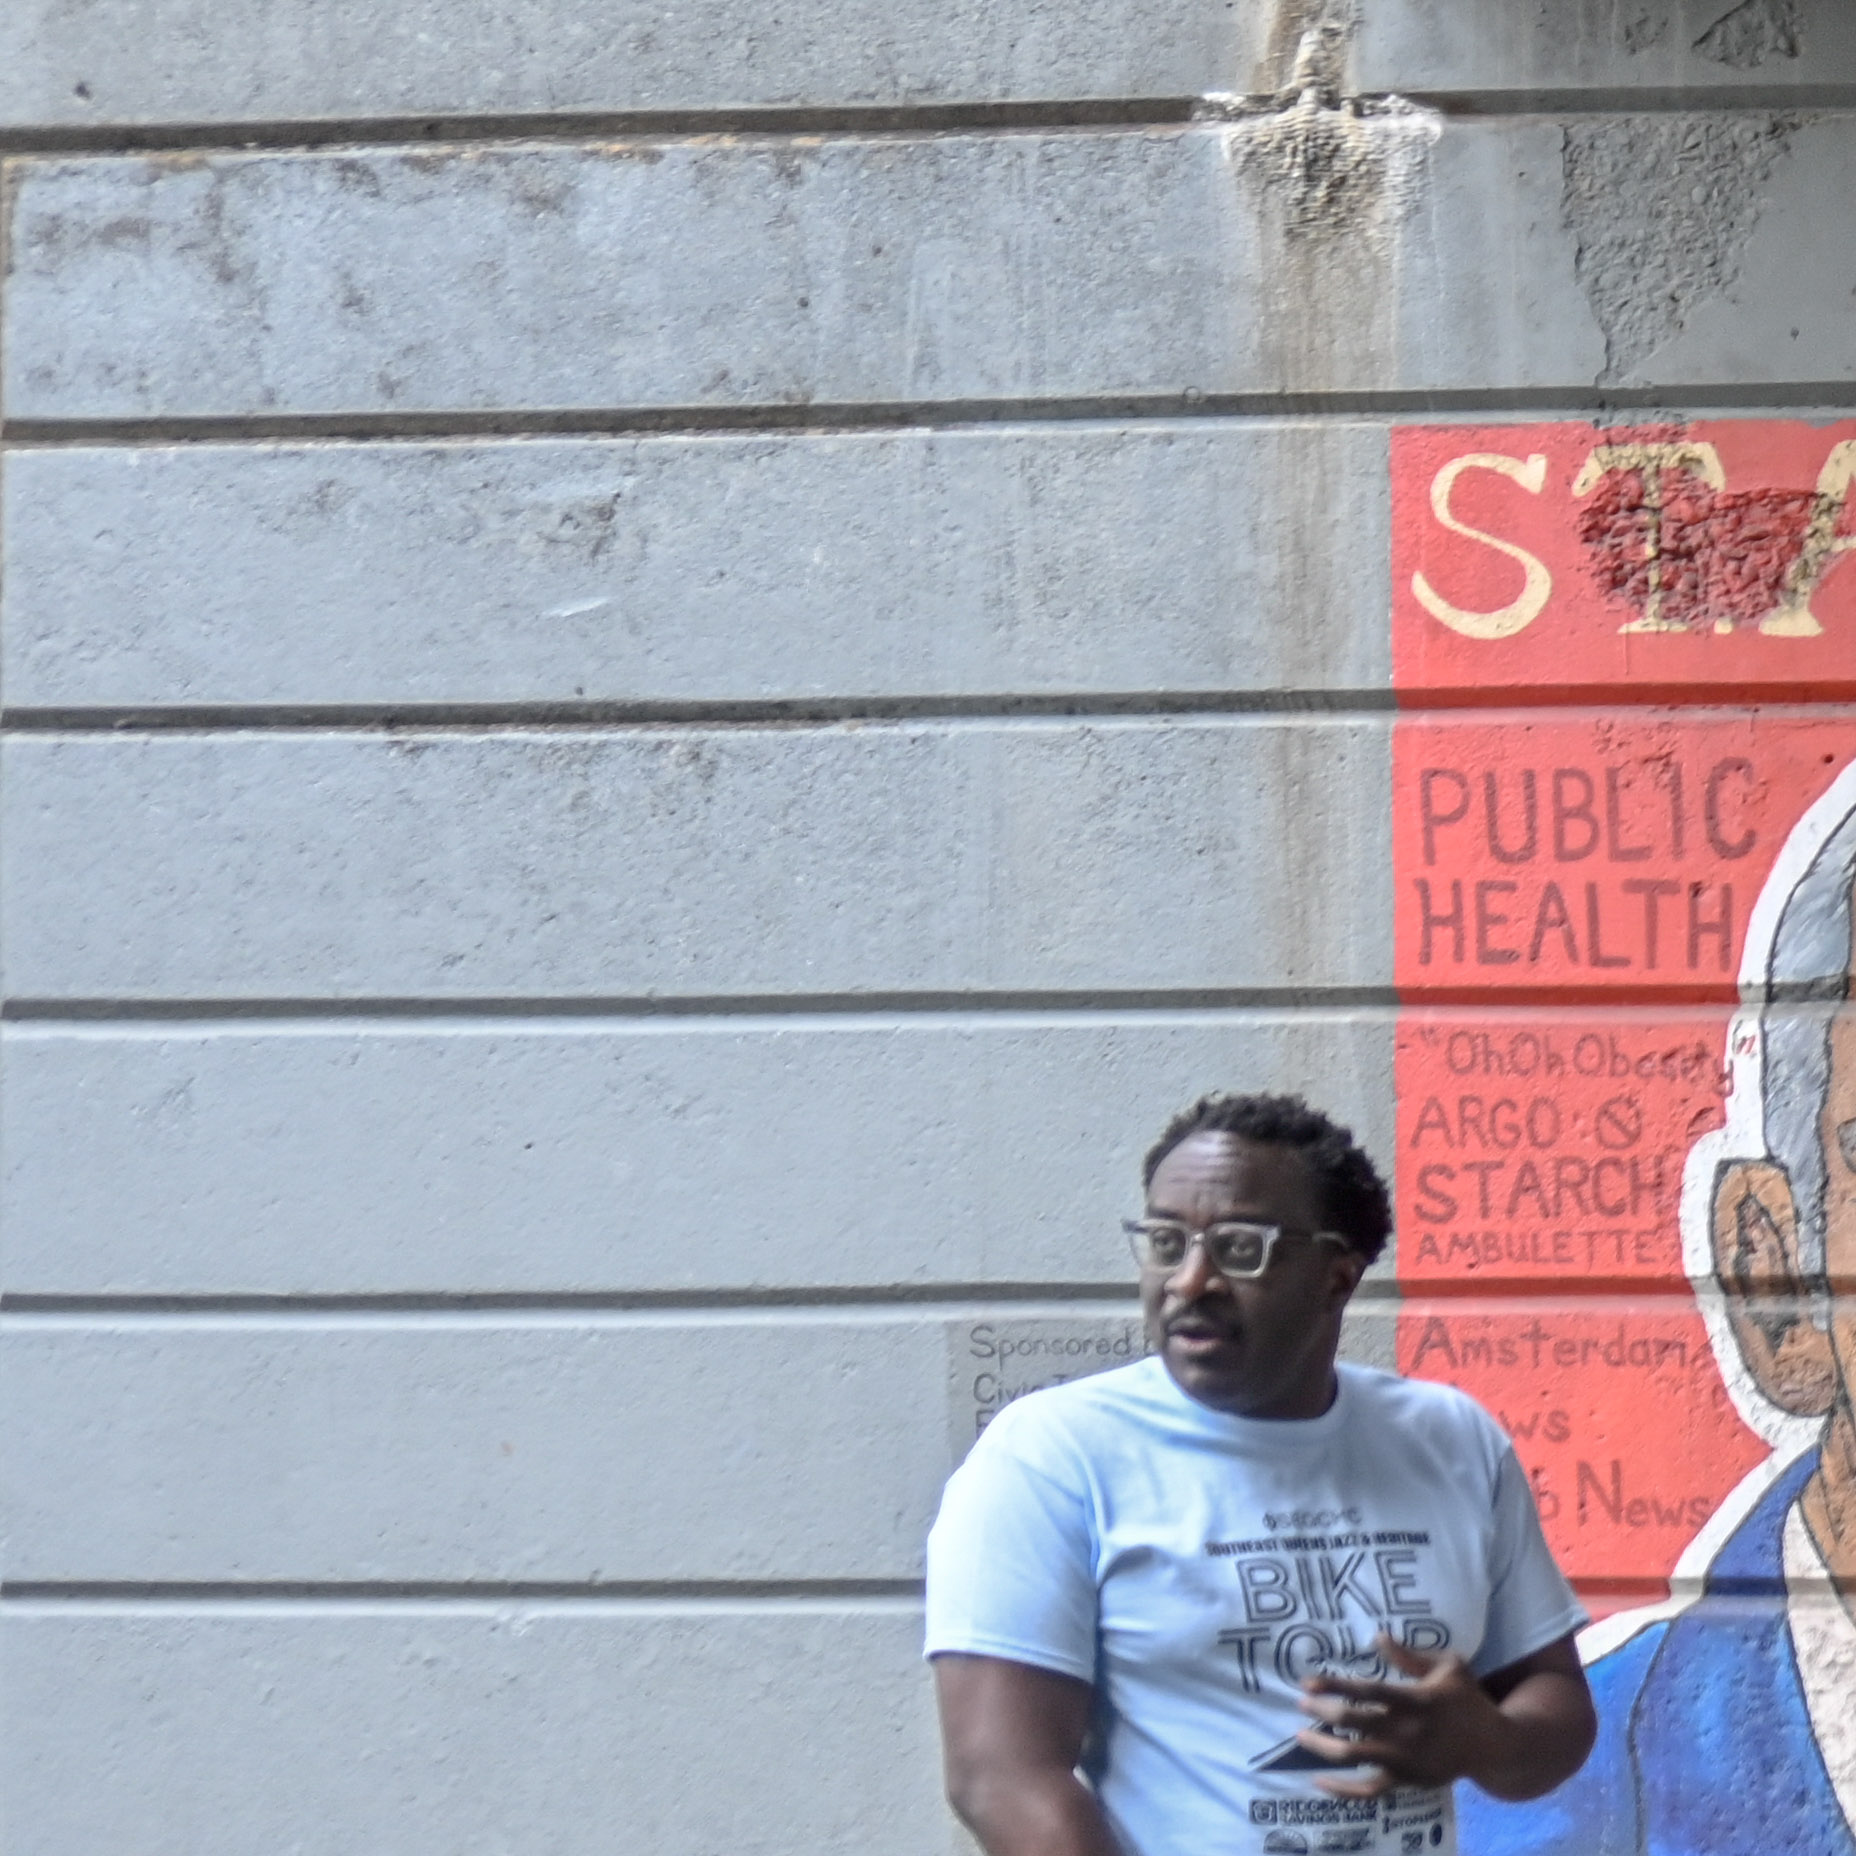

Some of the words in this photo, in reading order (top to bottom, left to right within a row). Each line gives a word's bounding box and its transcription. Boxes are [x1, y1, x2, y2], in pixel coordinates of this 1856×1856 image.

[1419, 756, 1757, 867] PUBLIC
[1413, 877, 1734, 971] HEALTH
[1410, 1094, 1562, 1150] ARGO
[1415, 1156, 1665, 1225] STARCH
[1415, 1229, 1659, 1267] AMBULETTE
[968, 1322, 1131, 1374] Sponsored
[1499, 1409, 1571, 1444] ws
[1576, 1457, 1712, 1529] News
[1234, 1549, 1432, 1624] BIKE
